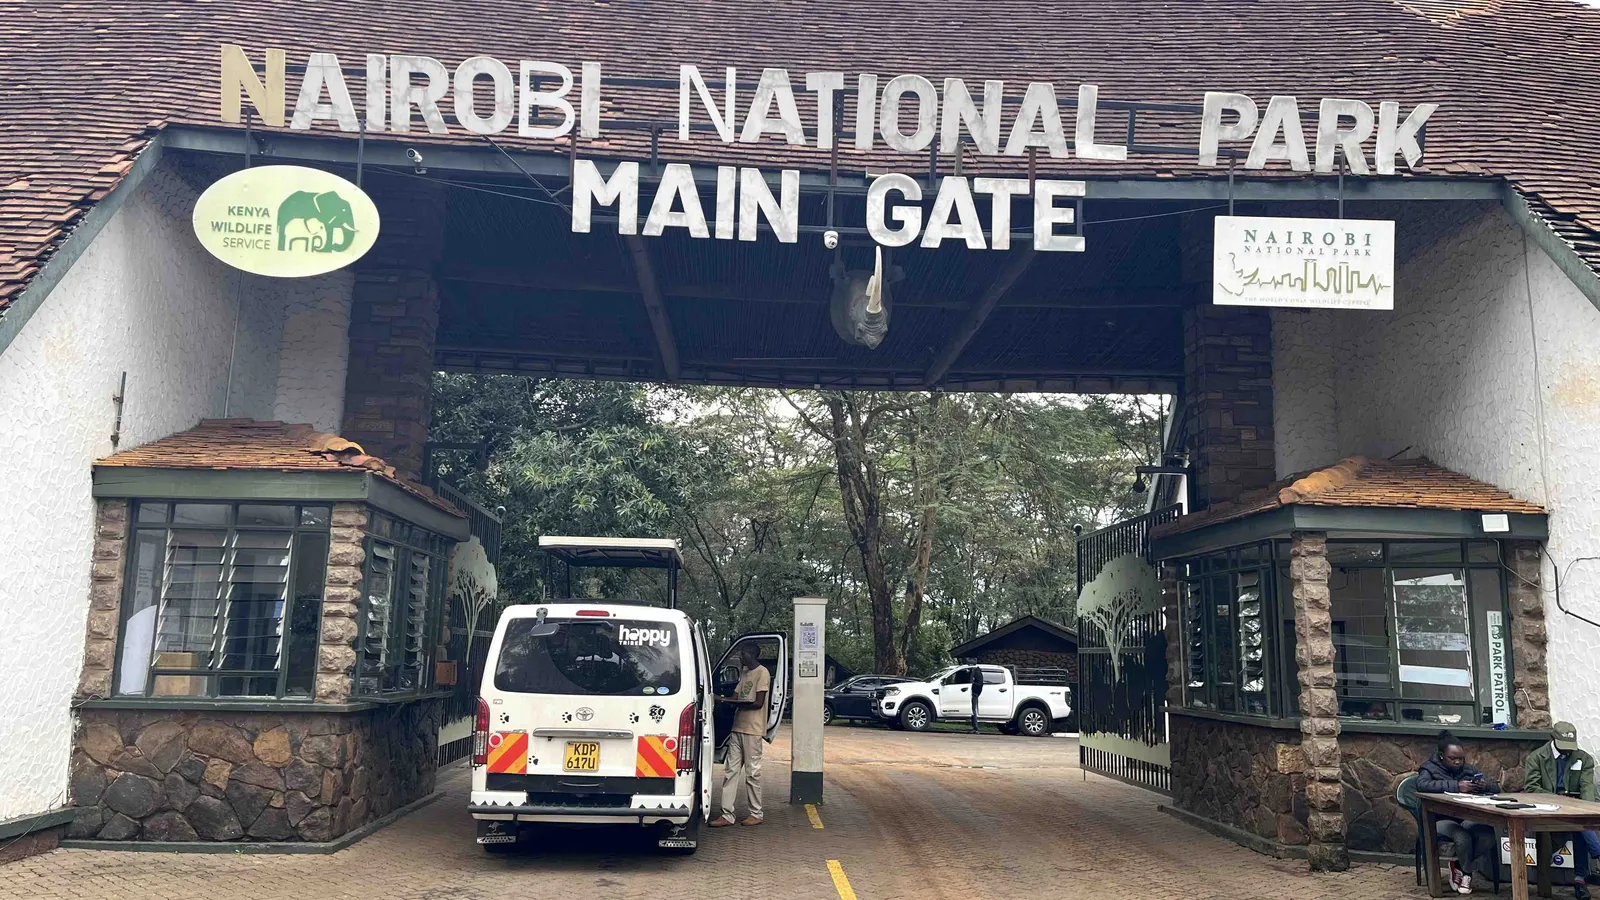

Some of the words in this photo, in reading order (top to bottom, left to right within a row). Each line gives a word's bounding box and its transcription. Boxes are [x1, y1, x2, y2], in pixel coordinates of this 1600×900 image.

[221, 44, 601, 140] NAIROBI
[679, 65, 1127, 161] NATIONAL
[1198, 92, 1439, 175] PARK
[228, 205, 270, 218] KENYA
[572, 160, 799, 243] MAIN
[866, 173, 1085, 253] GATE
[211, 221, 272, 235] WILDLIFE
[222, 237, 271, 250] SERVICE
[1244, 230, 1371, 246] NAIROBI
[1244, 245, 1325, 256] NATIONAL
[1333, 248, 1371, 256] PARK
[619, 624, 671, 647] happy
[1492, 641, 1503, 670] PARK
[1494, 672, 1505, 714] PATROL
[649, 707, 666, 717] 80
[573, 743, 597, 756] KDP
[566, 757, 596, 769] 617U
